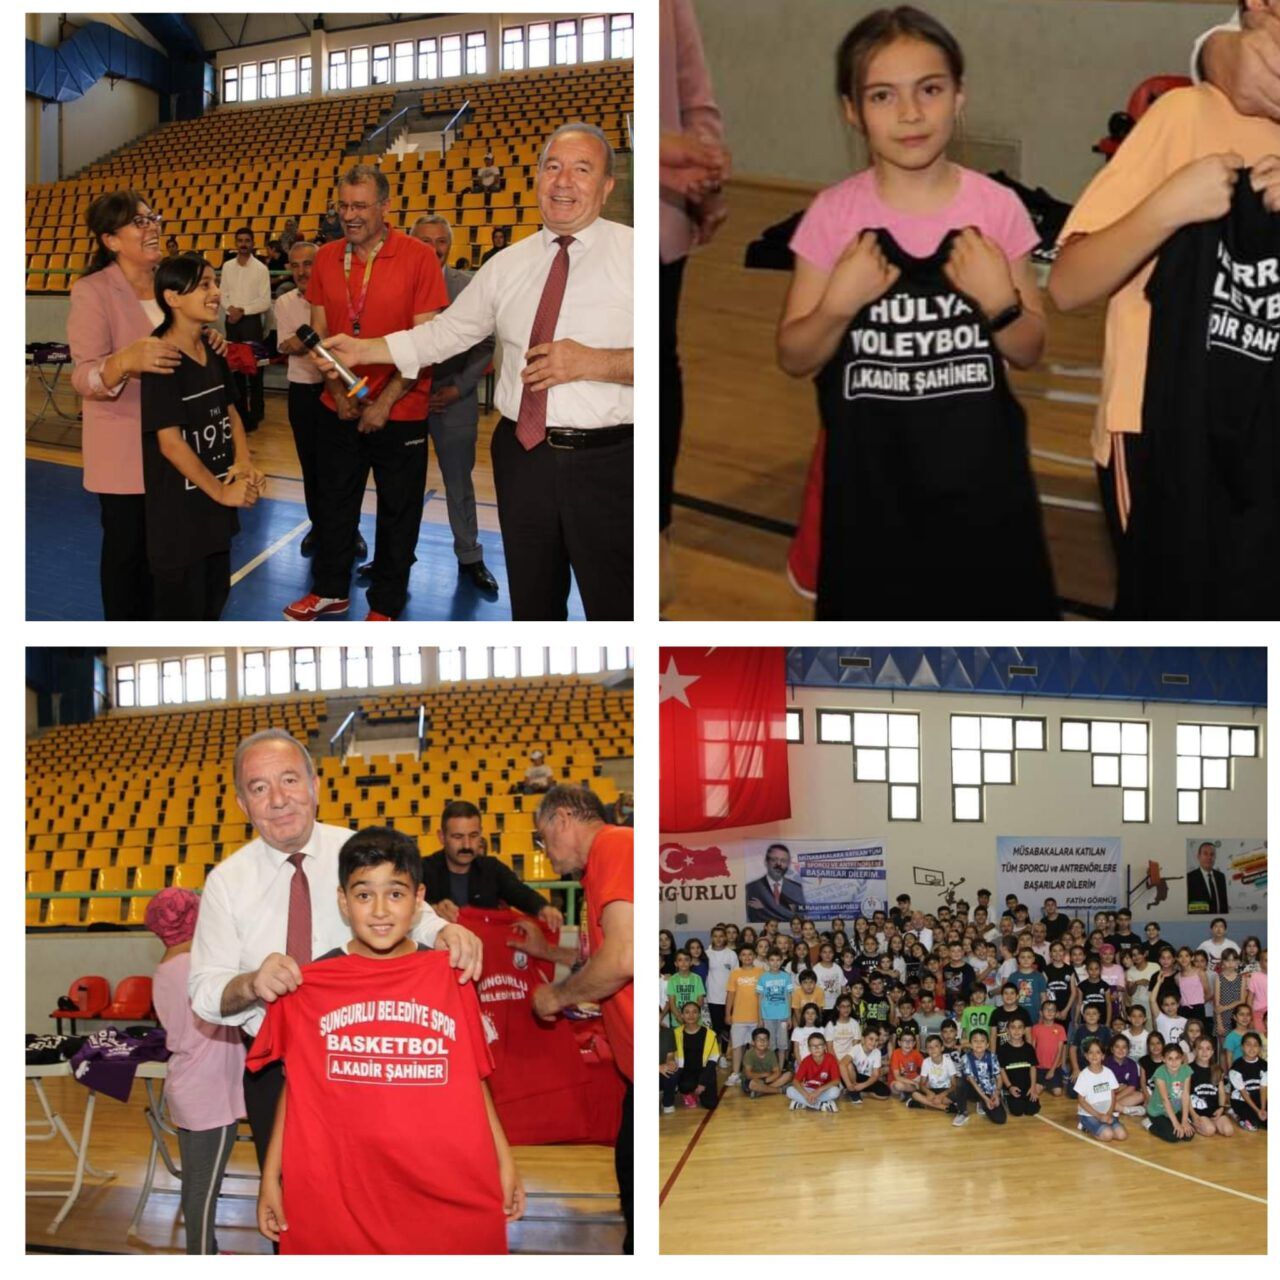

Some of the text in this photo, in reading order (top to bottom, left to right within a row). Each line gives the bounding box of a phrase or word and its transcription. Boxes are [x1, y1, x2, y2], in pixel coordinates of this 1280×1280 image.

[851, 323, 989, 357] VOLEYBOL
[914, 362, 988, 395] ŞAHİNER
[1013, 846, 1106, 856] MÜSABAKALARA KATILAN
[1001, 862, 1018, 873] TÜM
[1019, 864, 1049, 873] SPORCU
[1059, 863, 1117, 873] ANTRENÖRLERE
[1023, 879, 1096, 892] BAŞARILAR DİLERİM
[320, 998, 456, 1041] SUNGURLU BELEDİYE SPOR
[327, 1034, 448, 1055] BASKETBOL
[332, 1059, 443, 1082] A.KADİR ŞAHİNER
